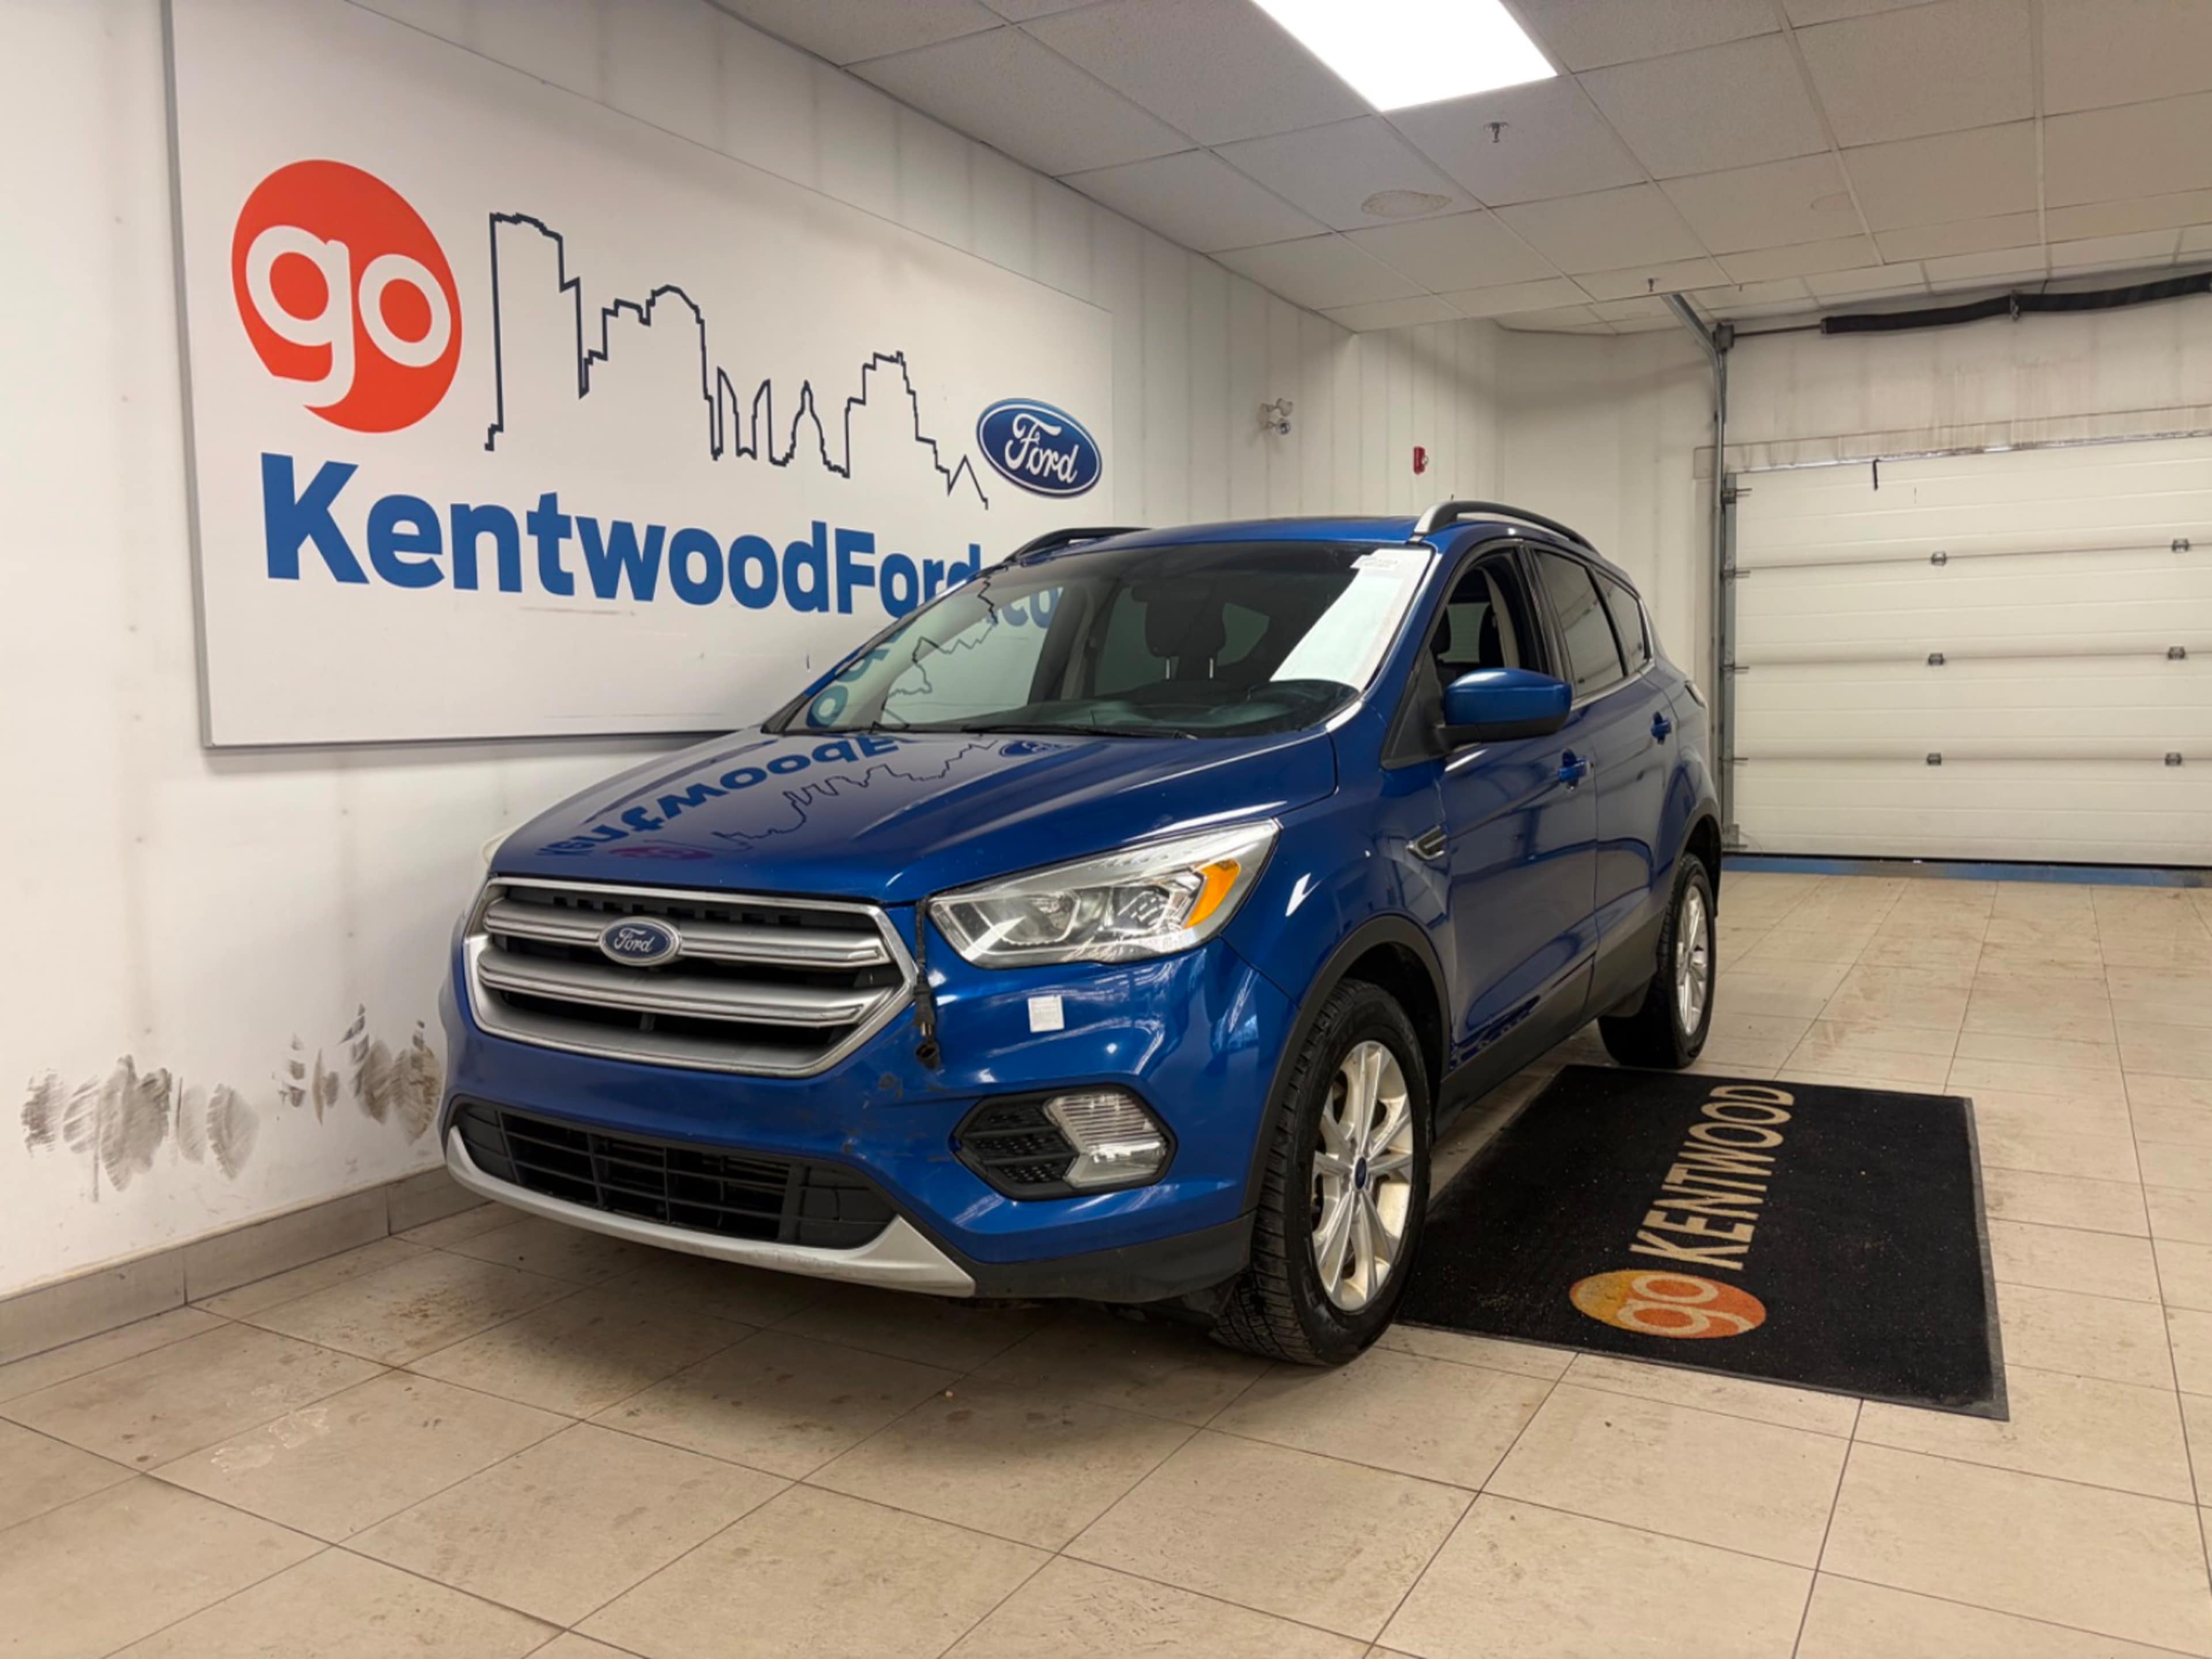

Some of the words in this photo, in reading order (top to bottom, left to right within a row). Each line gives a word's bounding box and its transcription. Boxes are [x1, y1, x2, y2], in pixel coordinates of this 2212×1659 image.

[245, 225, 452, 408] go
[1005, 413, 1079, 483] Ford
[613, 927, 656, 953] Ford
[1629, 1085, 1795, 1270] KENTWOOD
[1616, 1274, 1755, 1335] go
